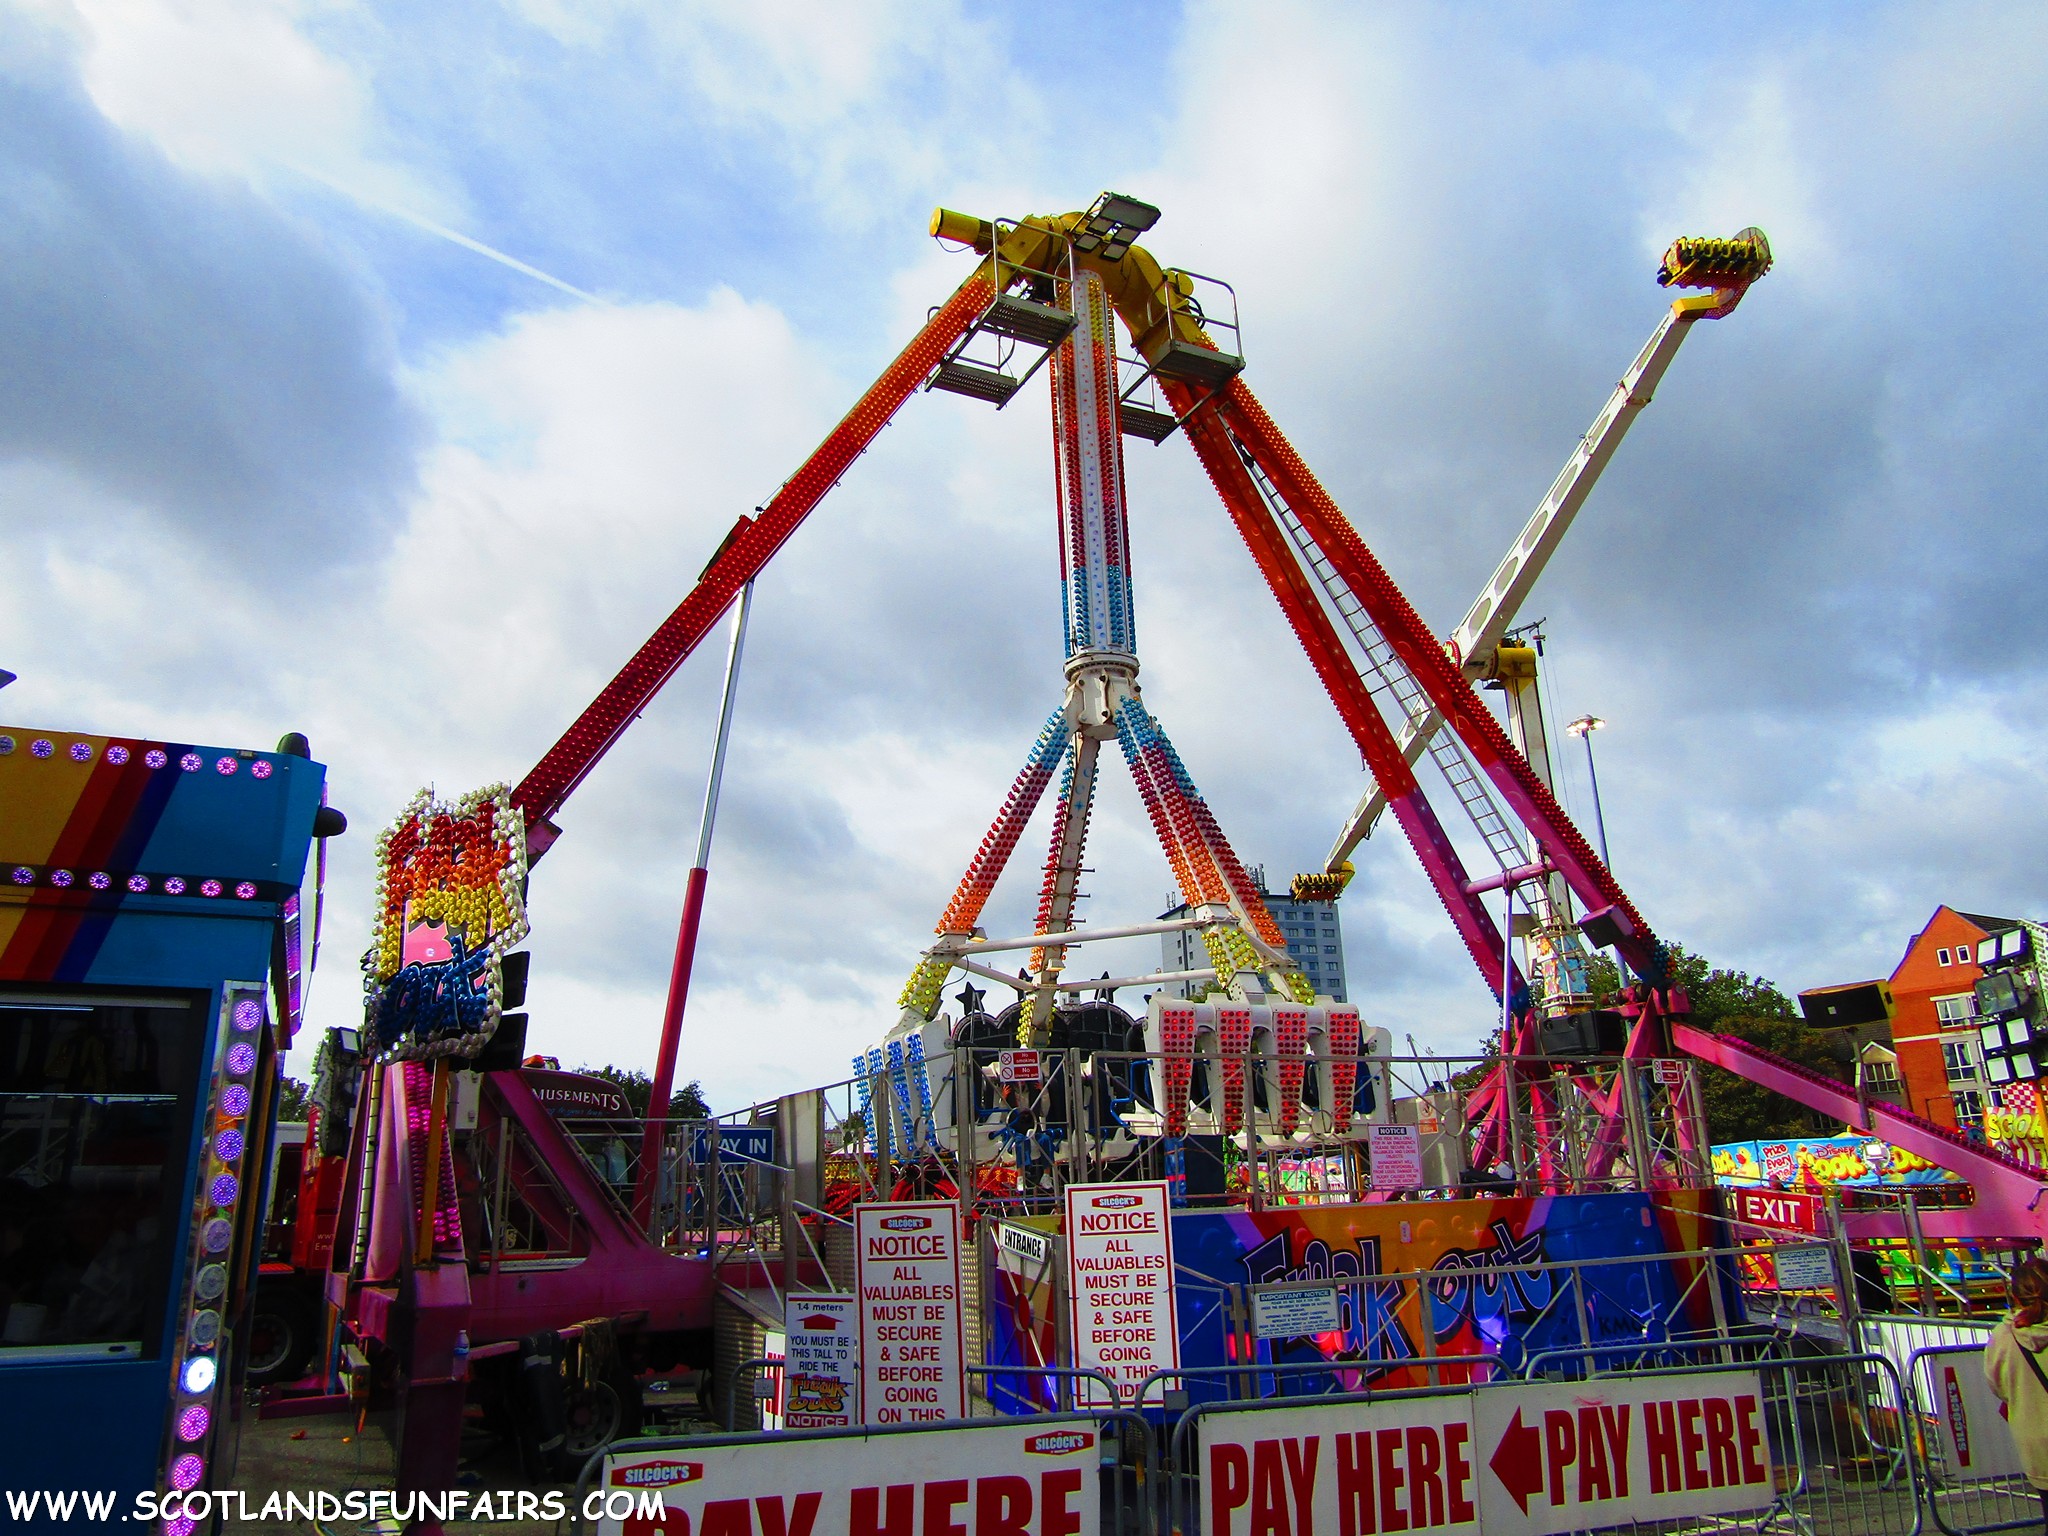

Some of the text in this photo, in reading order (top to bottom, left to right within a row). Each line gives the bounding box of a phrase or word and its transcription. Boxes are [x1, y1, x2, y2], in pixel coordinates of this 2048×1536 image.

[749, 1138, 767, 1154] IN
[1763, 1144, 1787, 1158] Prize
[1766, 1156, 1793, 1170] Every
[1099, 1197, 1135, 1206] SILCOCK'S
[1746, 1196, 1800, 1224] EXIT
[888, 1218, 924, 1228] SILCOCK'S
[1081, 1212, 1156, 1231] NOTICE
[869, 1235, 945, 1256] NOTICE
[1004, 1229, 1042, 1258] ENTRANCE
[1105, 1239, 1134, 1252] ALL
[1076, 1255, 1165, 1271] VALUABLES
[893, 1266, 922, 1280] ALL
[1085, 1273, 1157, 1289] MUST BE
[863, 1285, 954, 1300] VALUABLES
[1090, 1292, 1154, 1307] SECURE
[1260, 1290, 1329, 1301] IMPORTANT NOTICE
[797, 1303, 844, 1312] 1.4 meters
[873, 1306, 945, 1320] MUST BE
[1241, 1230, 1418, 1397] Fak
[1093, 1310, 1153, 1325] & SAFE
[877, 1326, 942, 1341] SECURE
[1092, 1328, 1156, 1343] BEFORE
[790, 1336, 849, 1347] YOU MUST BE
[791, 1348, 848, 1359] THIS TALL TO
[880, 1346, 940, 1361] & SAFE
[1099, 1346, 1151, 1362] GOING
[799, 1362, 838, 1372] RIDE THE
[878, 1367, 943, 1382] BEFORE
[788, 1372, 850, 1398] Freak
[885, 1387, 938, 1402] GOING
[789, 1415, 845, 1427] NOTICE
[878, 1407, 945, 1423] ON THIS
[1035, 1434, 1084, 1451] SILCOCK'S
[1545, 1394, 1767, 1505] PAY HERE
[625, 1465, 690, 1484] SILCOCK'S
[1209, 1435, 1320, 1536] PAY
[1336, 1422, 1476, 1536] HERE
